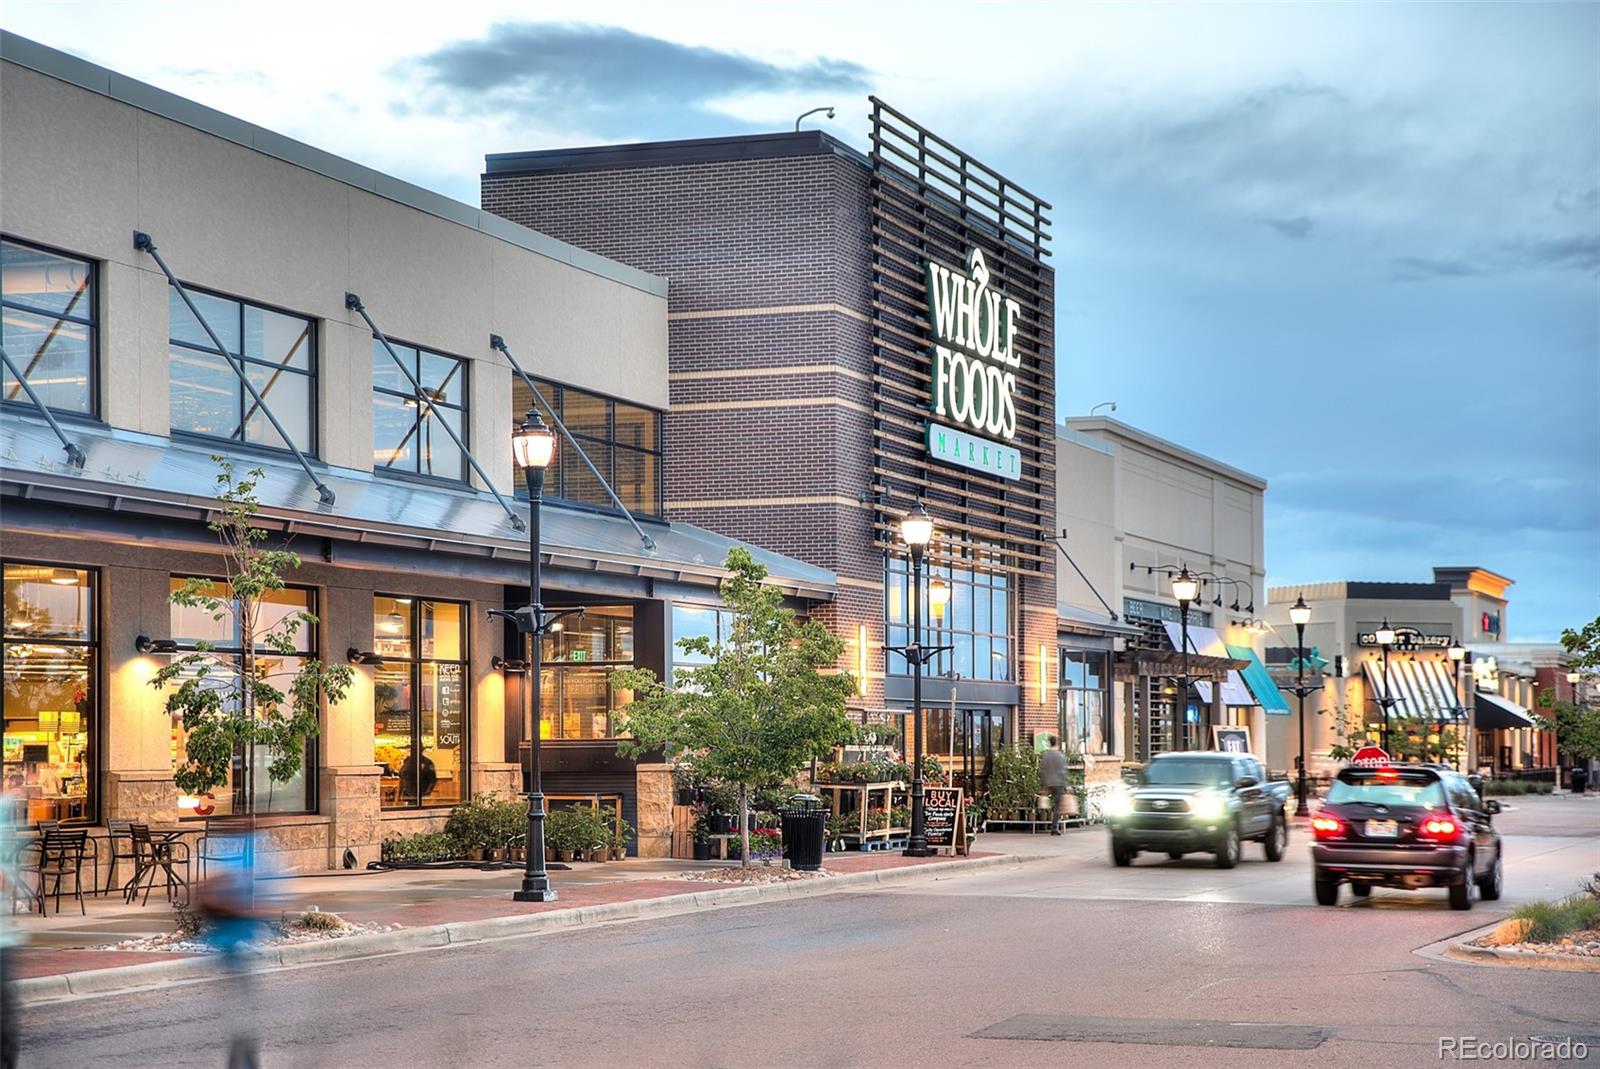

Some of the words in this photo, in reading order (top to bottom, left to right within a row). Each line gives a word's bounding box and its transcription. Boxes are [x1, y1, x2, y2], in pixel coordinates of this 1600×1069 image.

[929, 250, 1021, 368] WHOLE
[936, 346, 1016, 440] FOODS
[937, 432, 1017, 474] MARKET
[573, 651, 586, 661] EXIT
[925, 798, 957, 808] LOCAL
[931, 790, 953, 800] BUY
